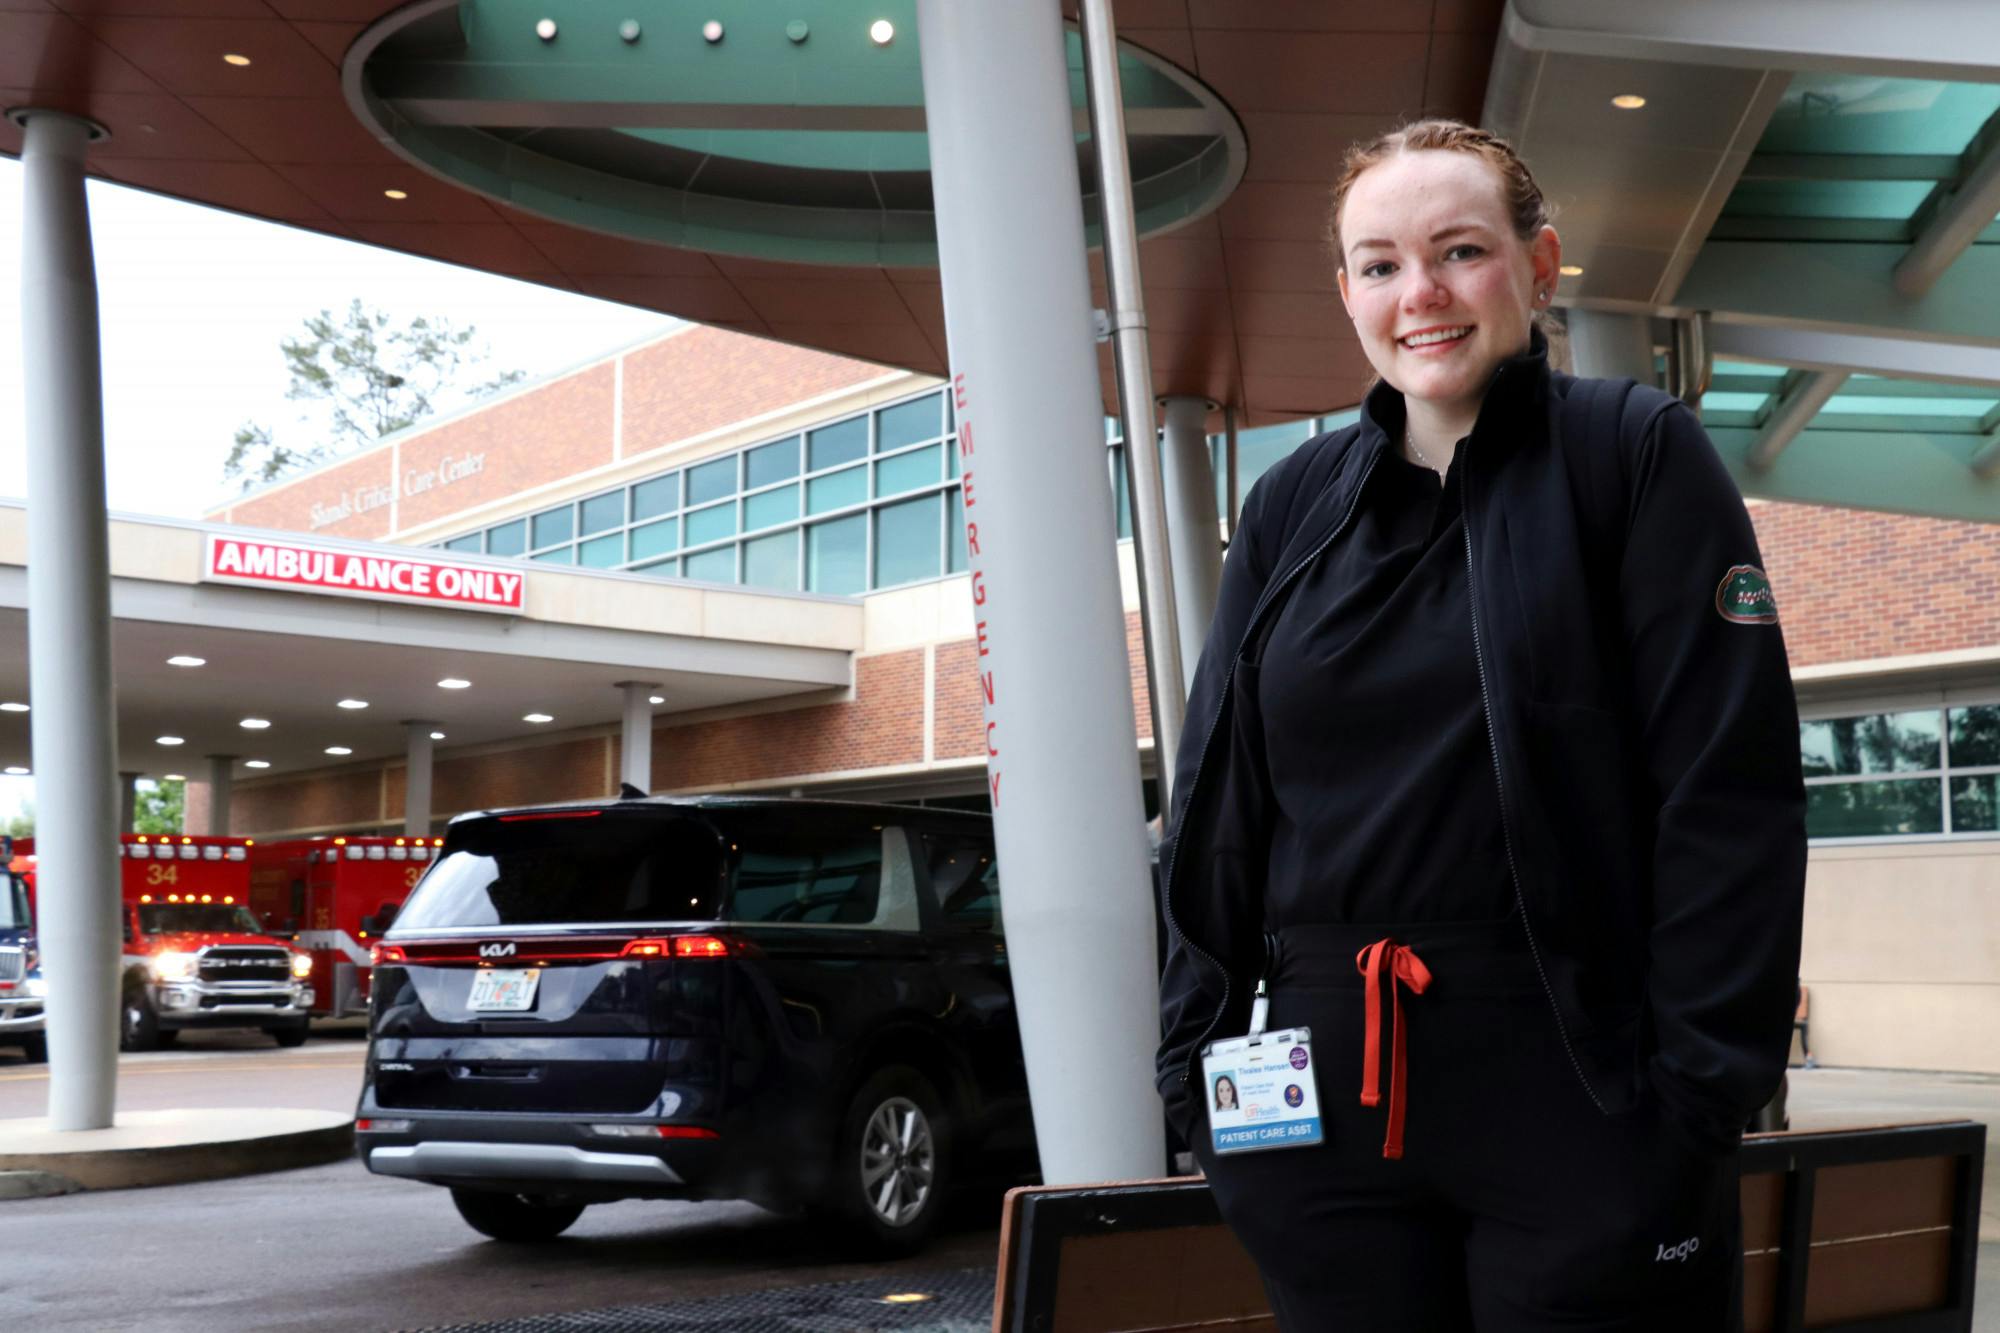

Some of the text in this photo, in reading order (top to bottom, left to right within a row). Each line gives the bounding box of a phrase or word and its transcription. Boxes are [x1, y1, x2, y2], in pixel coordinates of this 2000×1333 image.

[404, 469, 435, 496] Care
[440, 452, 485, 485] Center
[217, 541, 519, 603] AMBULANCE ONLY
[147, 863, 177, 885] 34
[479, 943, 516, 957] KIA
[1220, 1124, 1312, 1143] PATIENT CARE ASST
